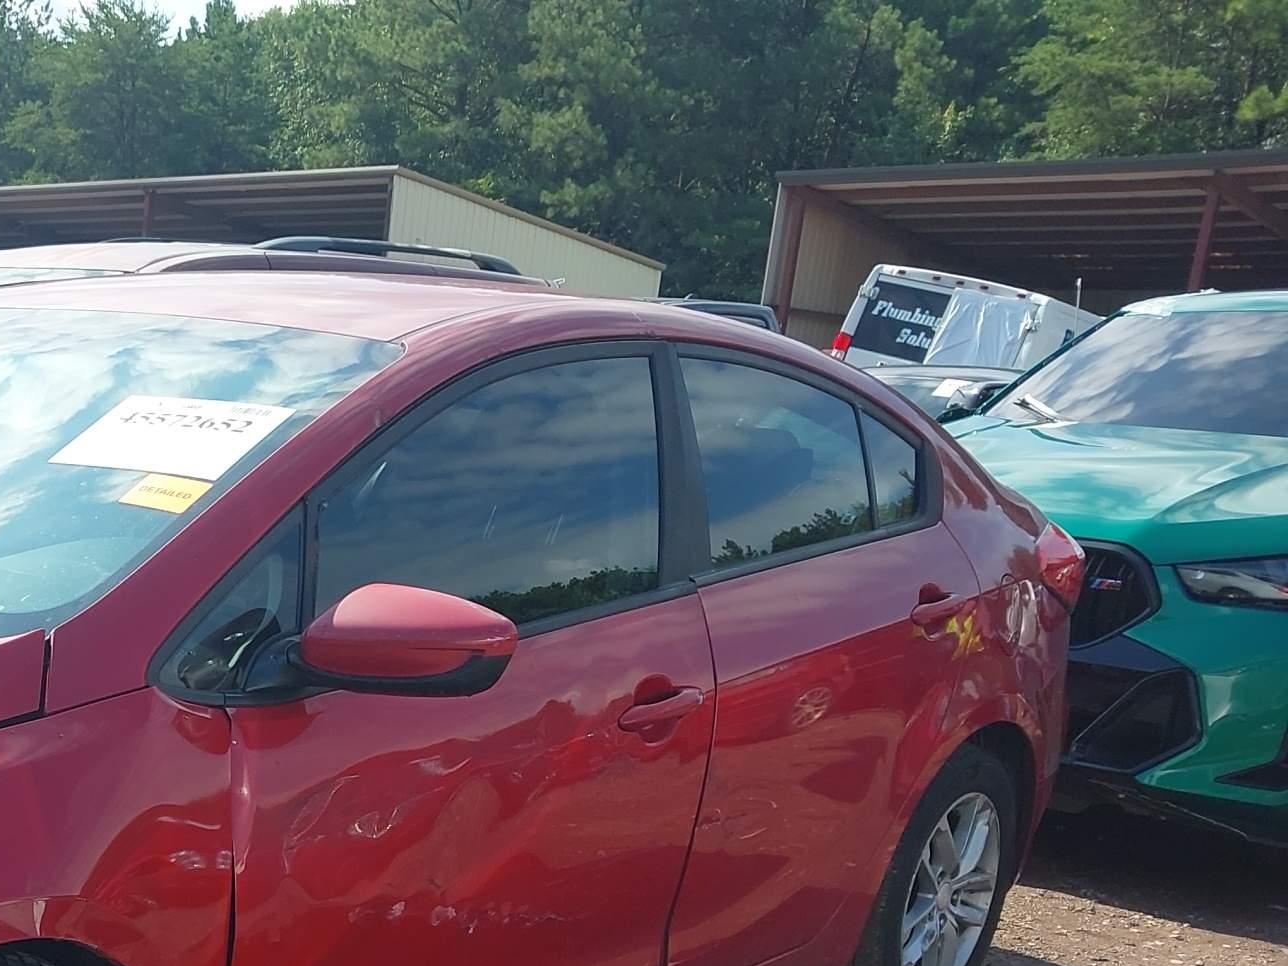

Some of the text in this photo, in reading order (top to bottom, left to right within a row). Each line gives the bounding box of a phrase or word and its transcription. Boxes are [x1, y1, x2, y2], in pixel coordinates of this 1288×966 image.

[871, 300, 943, 331] Plumbing
[119, 411, 254, 433] 45572652
[138, 486, 193, 500] DETAILED
